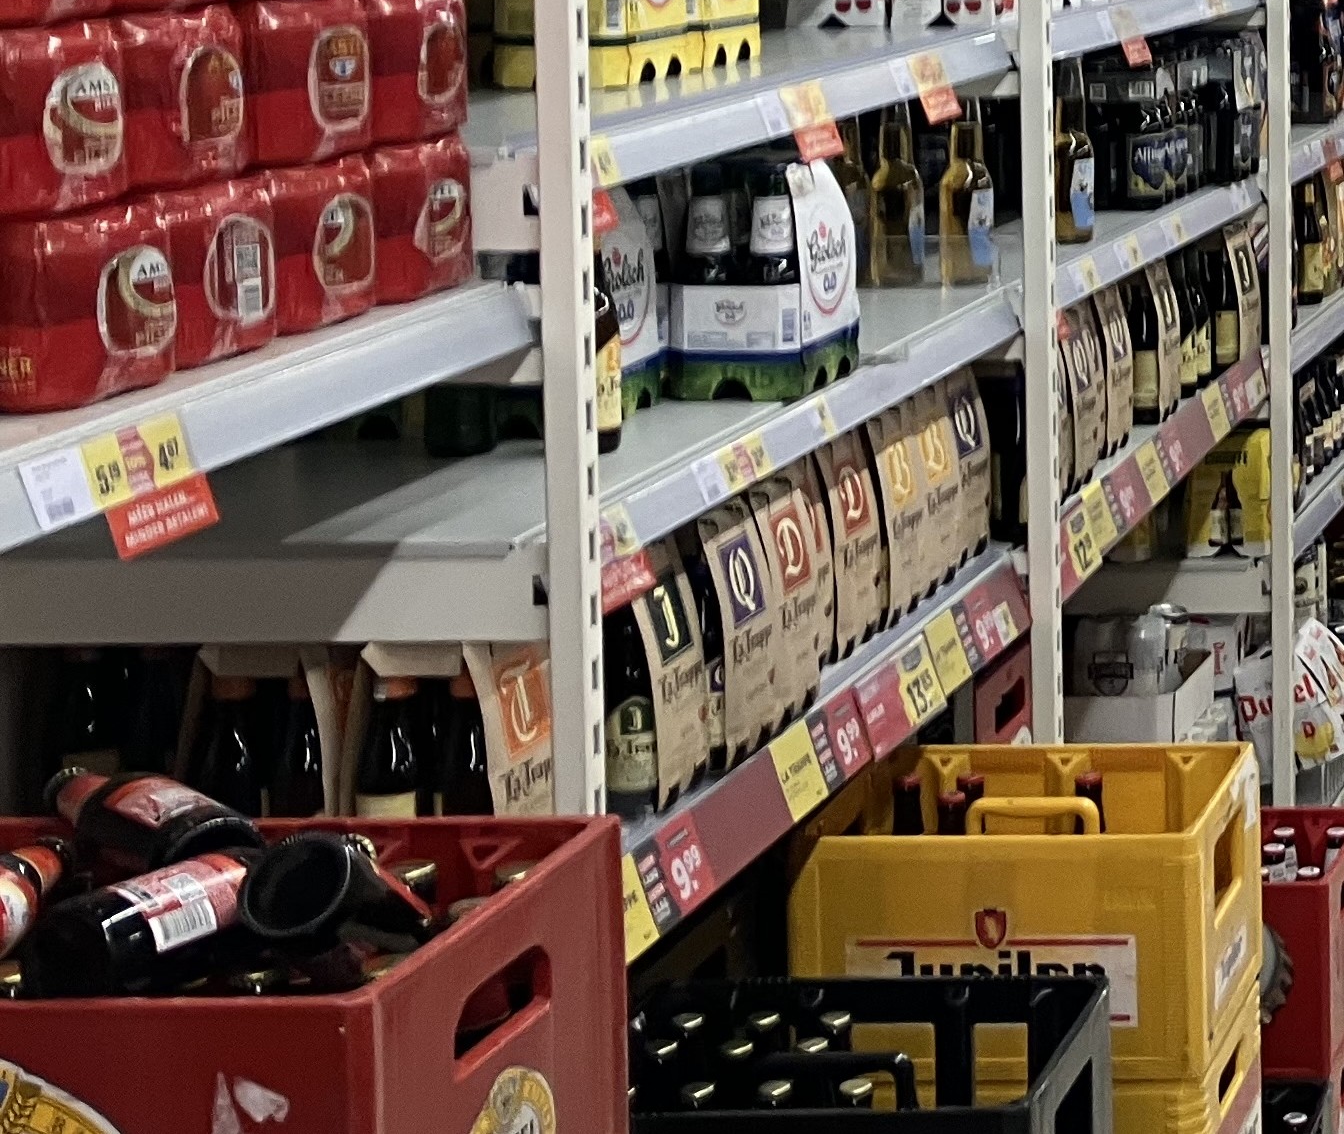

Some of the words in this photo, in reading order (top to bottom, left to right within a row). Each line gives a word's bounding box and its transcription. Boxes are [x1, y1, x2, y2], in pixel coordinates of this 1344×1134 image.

[1238, 672, 1315, 723] Duel
[836, 717, 861, 765] 9.99
[670, 841, 702, 902] 9.99
